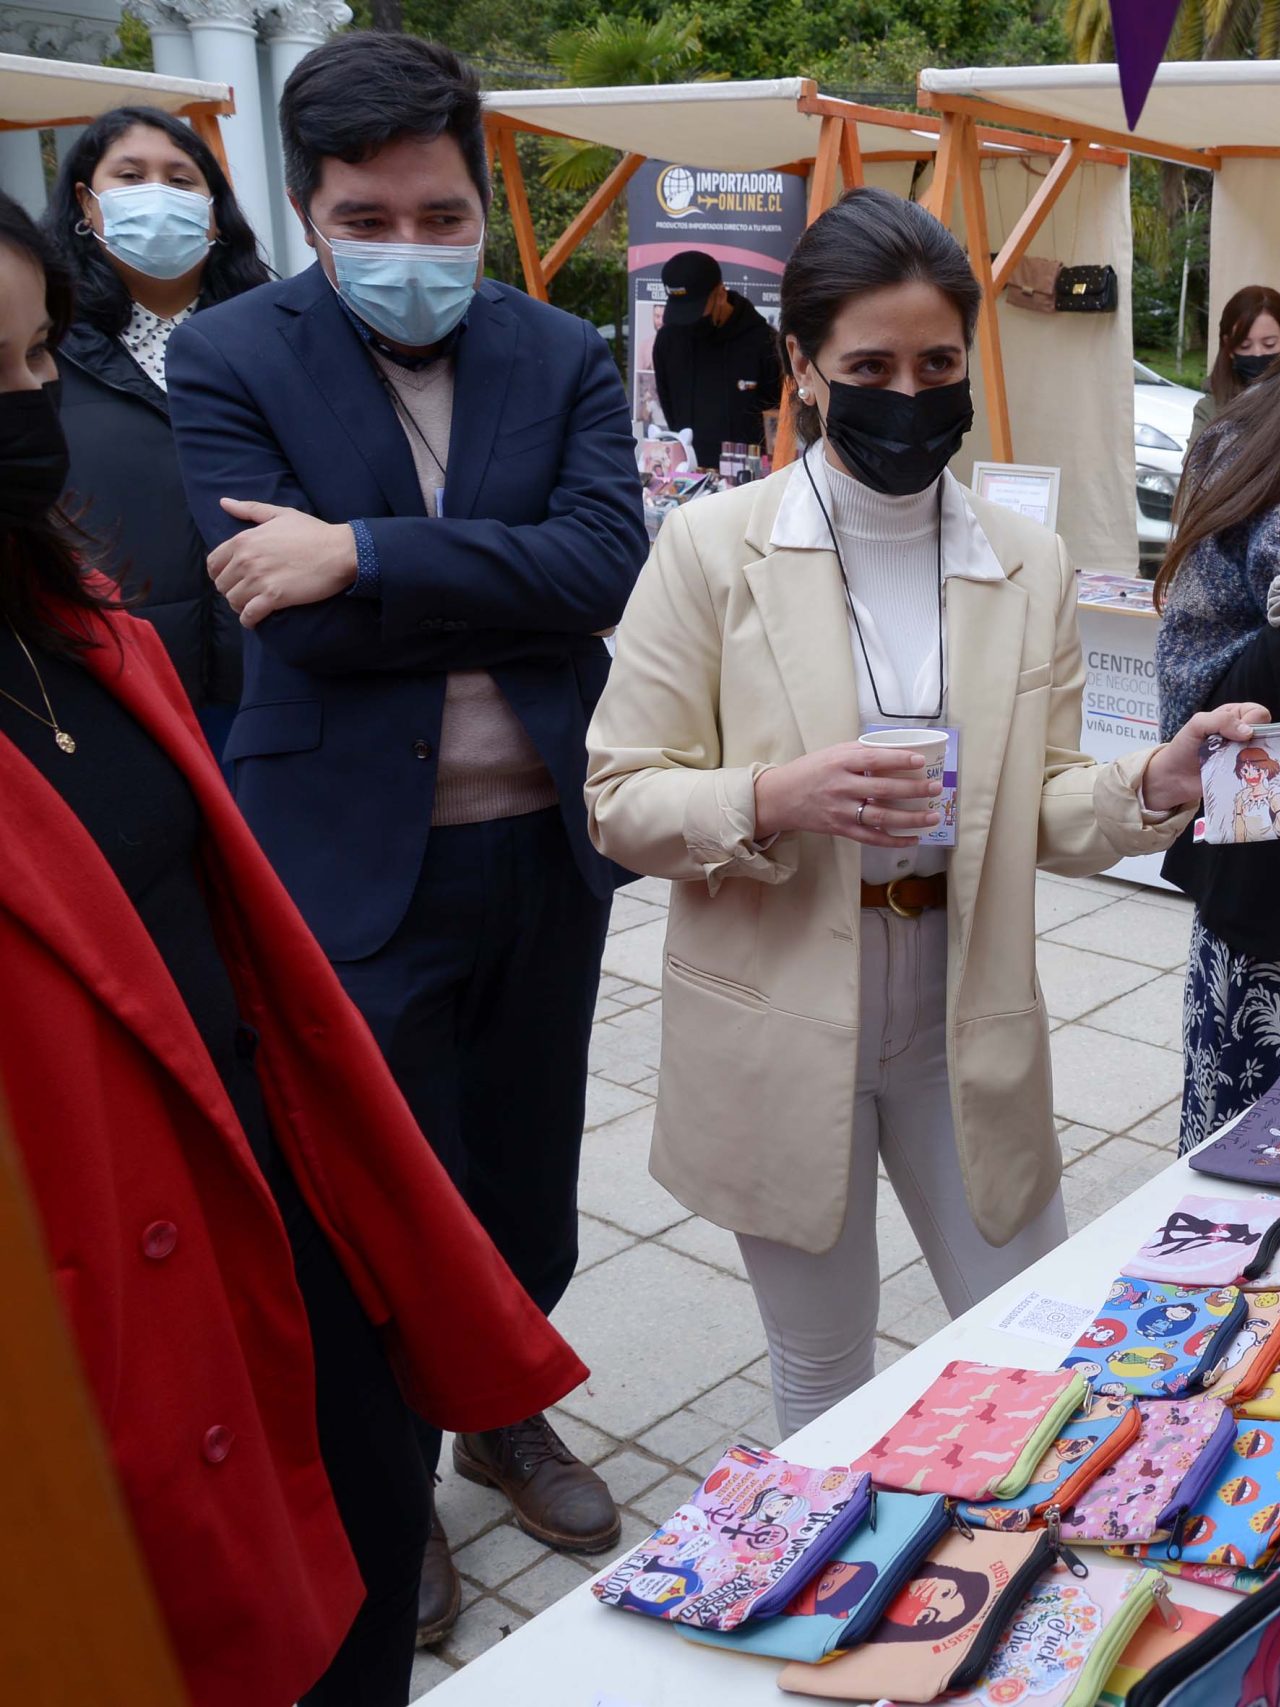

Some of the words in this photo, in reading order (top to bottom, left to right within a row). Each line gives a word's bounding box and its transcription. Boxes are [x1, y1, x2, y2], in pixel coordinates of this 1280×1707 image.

[697, 172, 783, 193] IMPORTADORA
[718, 194, 782, 212] ONLINE.CL
[656, 221, 688, 230] PRODUCTOS
[688, 222, 723, 231] IMPORTADOS
[723, 223, 748, 231] DIRECTO
[753, 224, 761, 232] TU
[1087, 651, 1157, 679] CENTRO
[1087, 671, 1102, 687] DE
[1086, 718, 1113, 735] VIÑA
[1115, 725, 1137, 739] DEL
[1139, 730, 1159, 743] MA
[1004, 1620, 1040, 1654] The
[1035, 1617, 1076, 1668] Fuck
